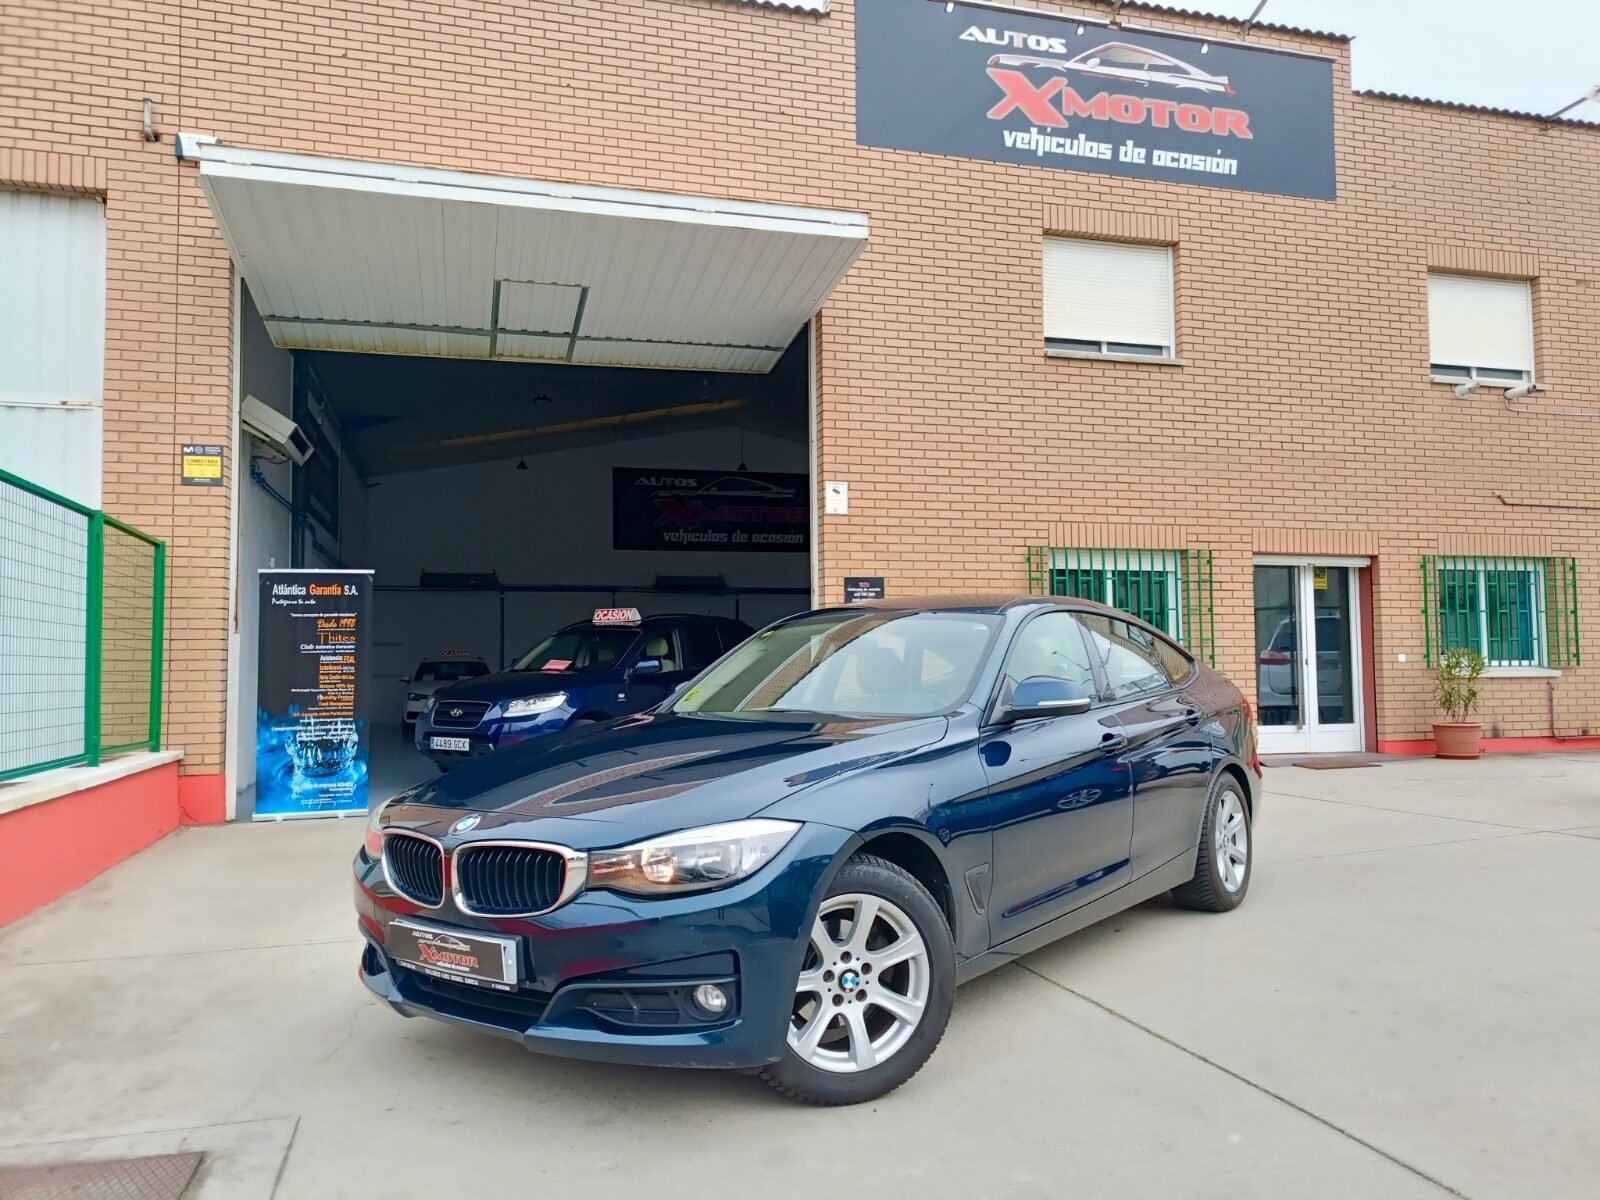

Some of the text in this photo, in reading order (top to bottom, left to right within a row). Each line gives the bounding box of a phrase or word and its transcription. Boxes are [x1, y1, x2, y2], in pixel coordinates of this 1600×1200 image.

[959, 25, 1067, 54] AUTOS
[985, 67, 1254, 140] XMOTOR
[1003, 126, 1237, 175] vehículos de ocasión
[634, 477, 698, 487] AUTOS
[732, 530, 748, 543] de
[272, 584, 358, 595] Atlántica Garantía S.A.
[595, 609, 633, 620] OCASION
[435, 738, 466, 749] 4489 GCX
